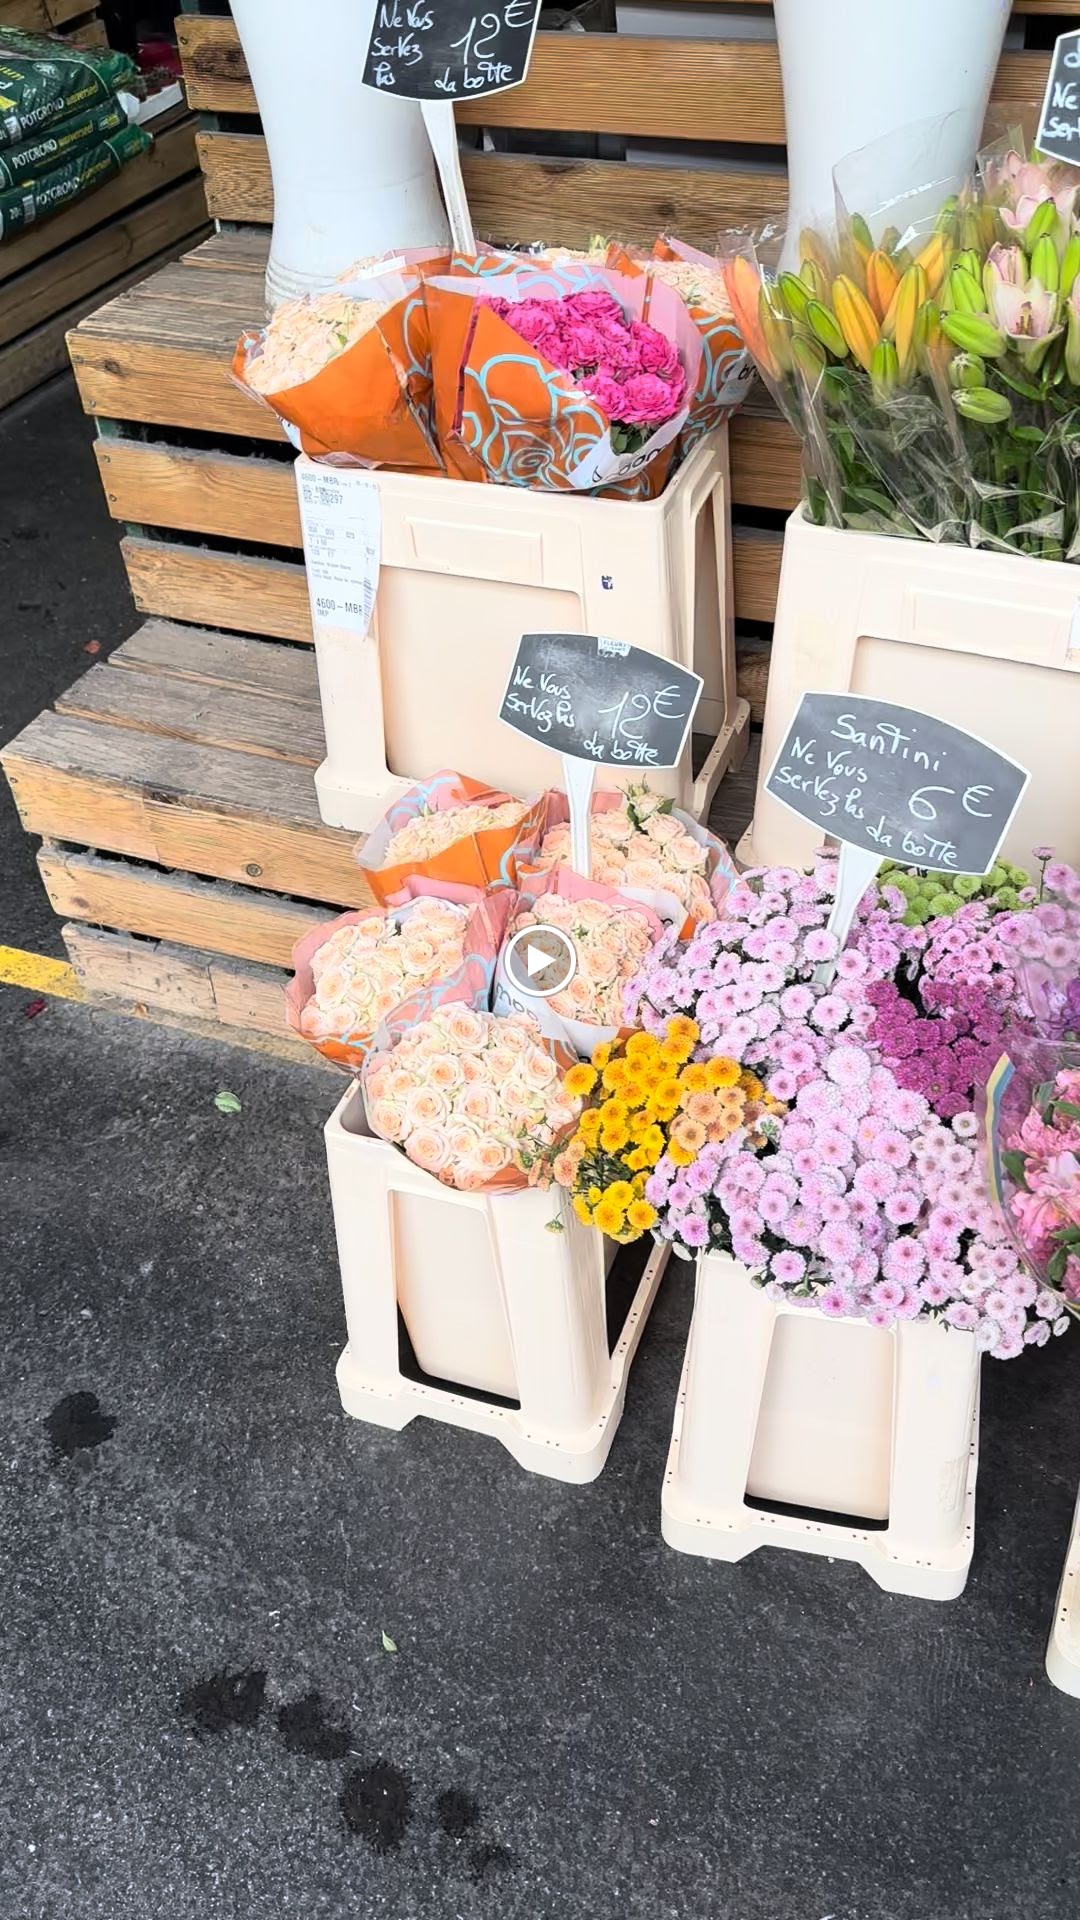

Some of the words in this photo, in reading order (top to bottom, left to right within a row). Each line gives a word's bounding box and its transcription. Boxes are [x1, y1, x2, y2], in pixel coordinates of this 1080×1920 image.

[20, 97, 65, 128] POTGROND
[12, 139, 57, 169] POTGROND
[513, 666, 534, 689] Ne
[540, 673, 571, 699] Vous
[791, 736, 816, 765] Ne
[827, 751, 868, 783] Vous
